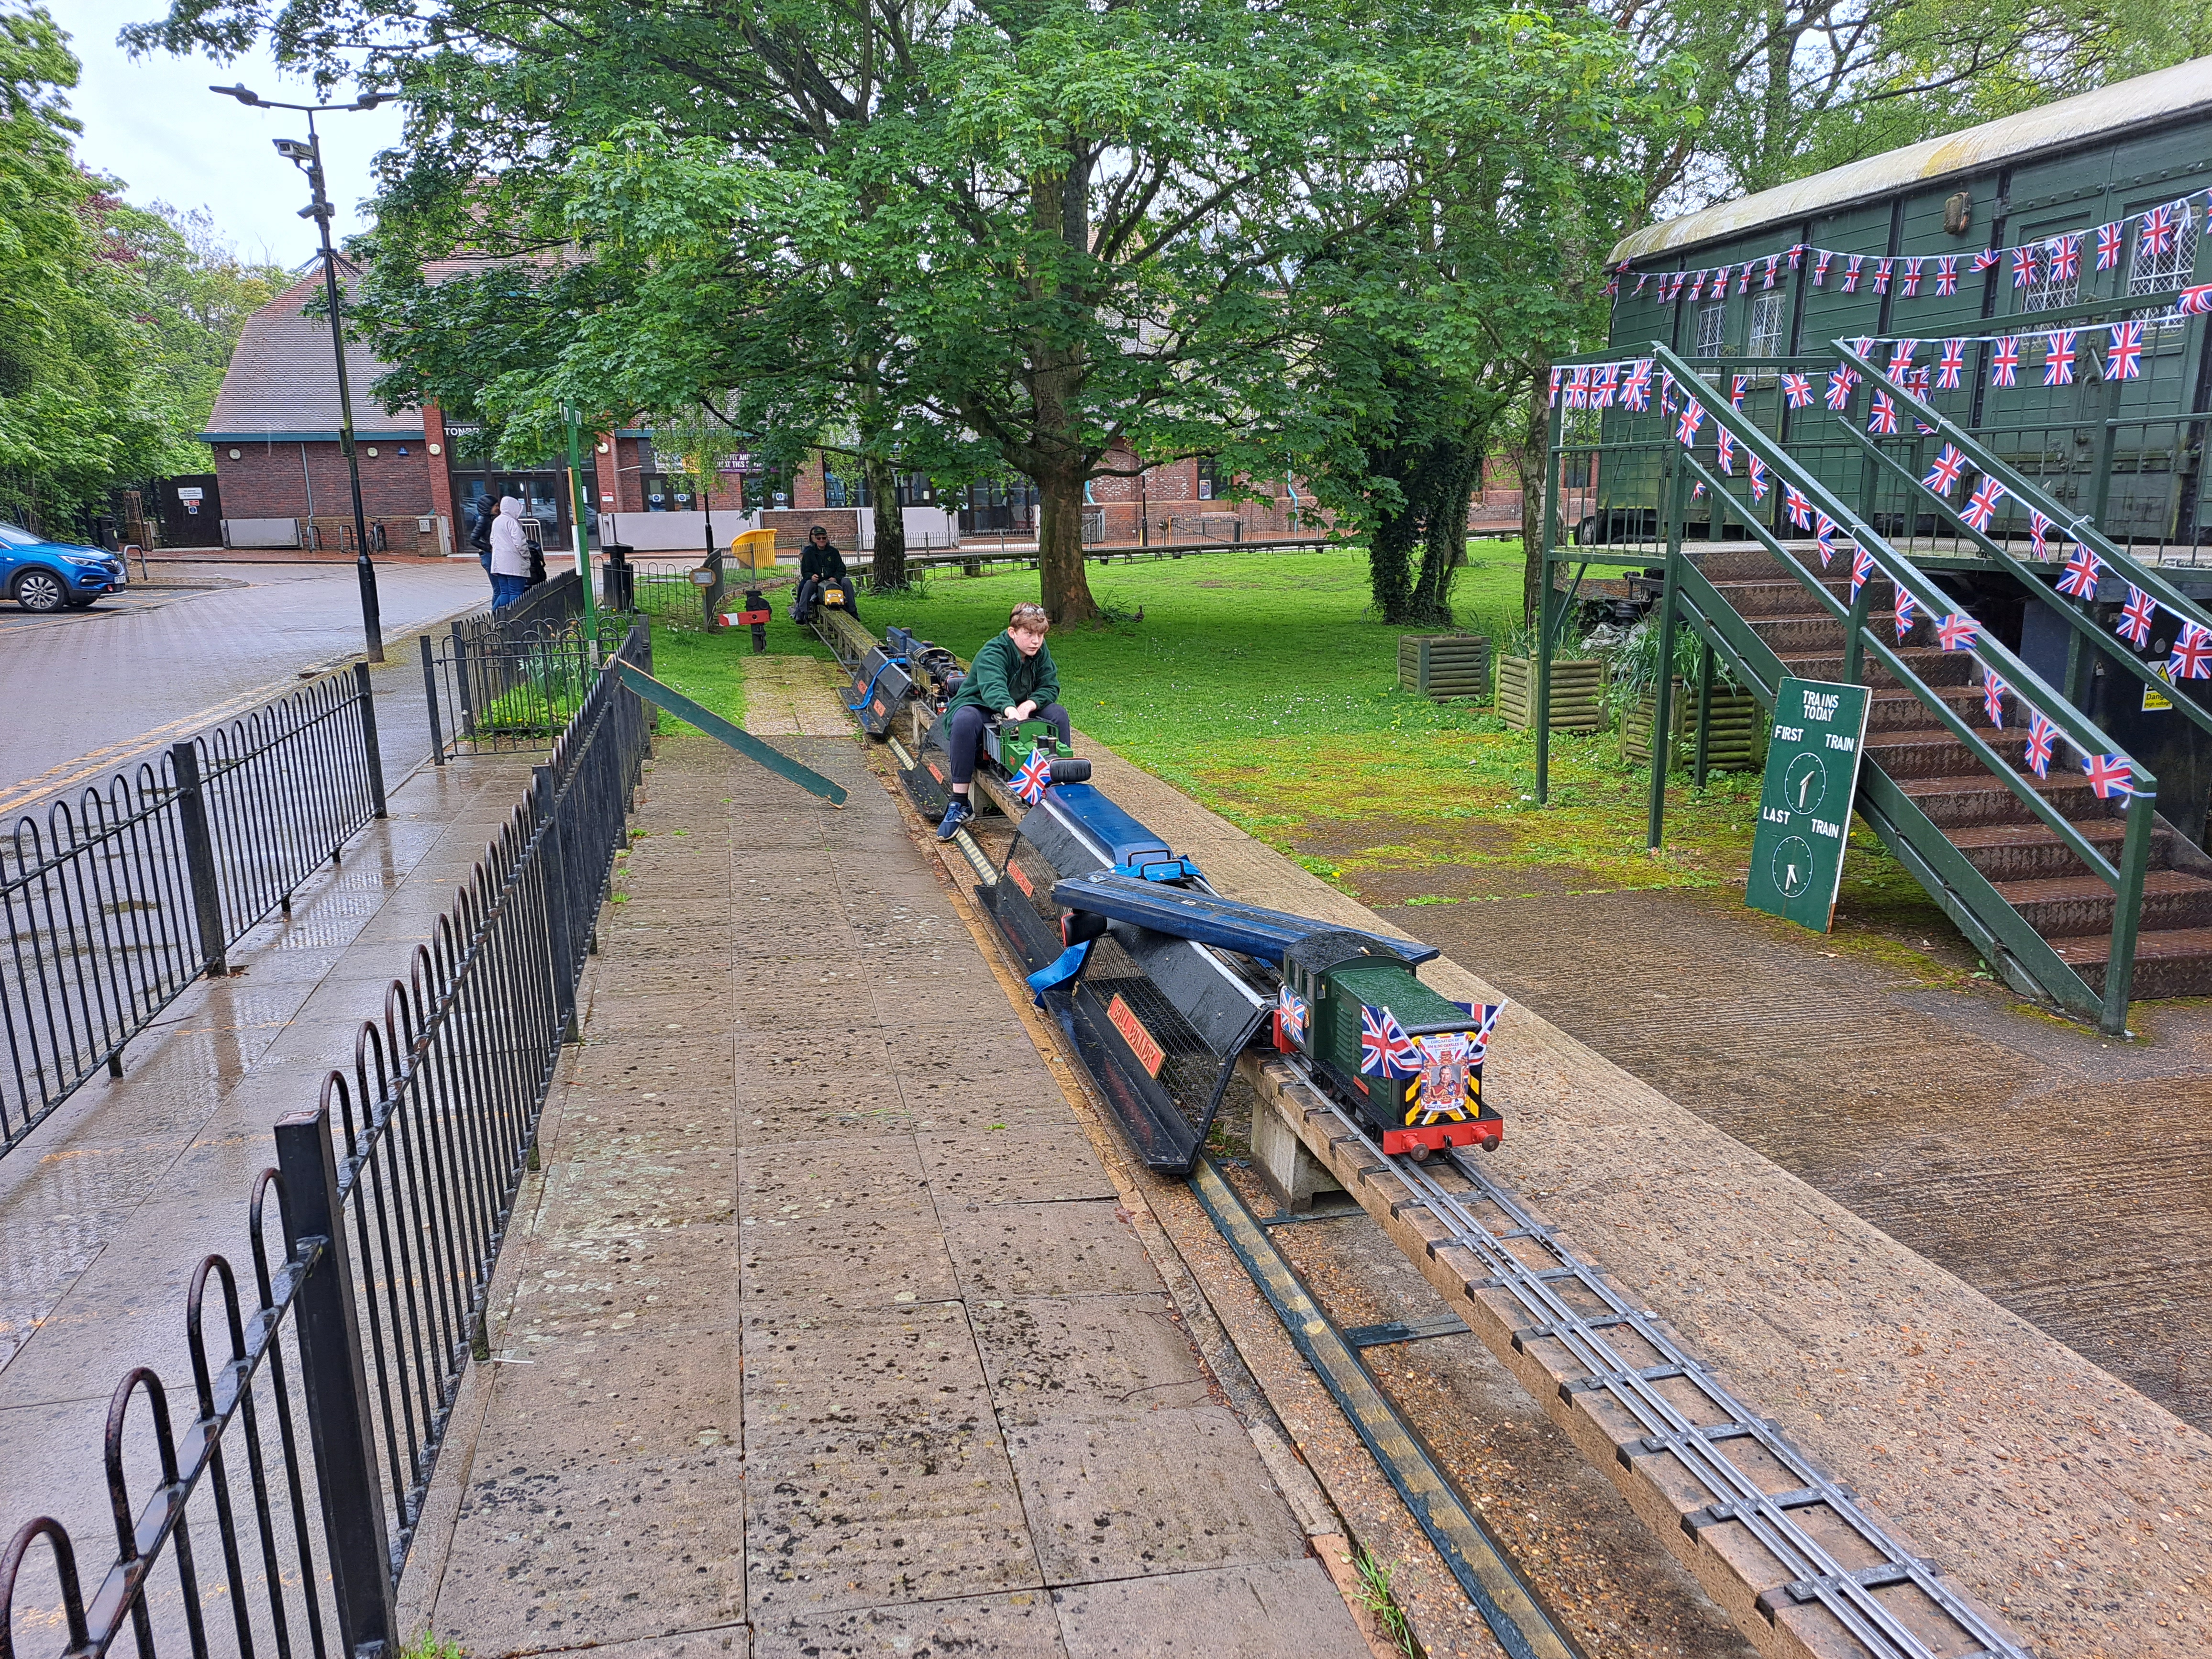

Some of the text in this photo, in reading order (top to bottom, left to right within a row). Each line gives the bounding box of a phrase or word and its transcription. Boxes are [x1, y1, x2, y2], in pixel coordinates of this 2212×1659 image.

[1803, 690, 1839, 708] TRAINS
[1804, 705, 1834, 721] TODAY
[1774, 725, 1854, 752] FIRST TRAIN
[1763, 806, 1839, 839] LAST TRAIN
[1113, 1003, 1156, 1068] BILL CONNOR
